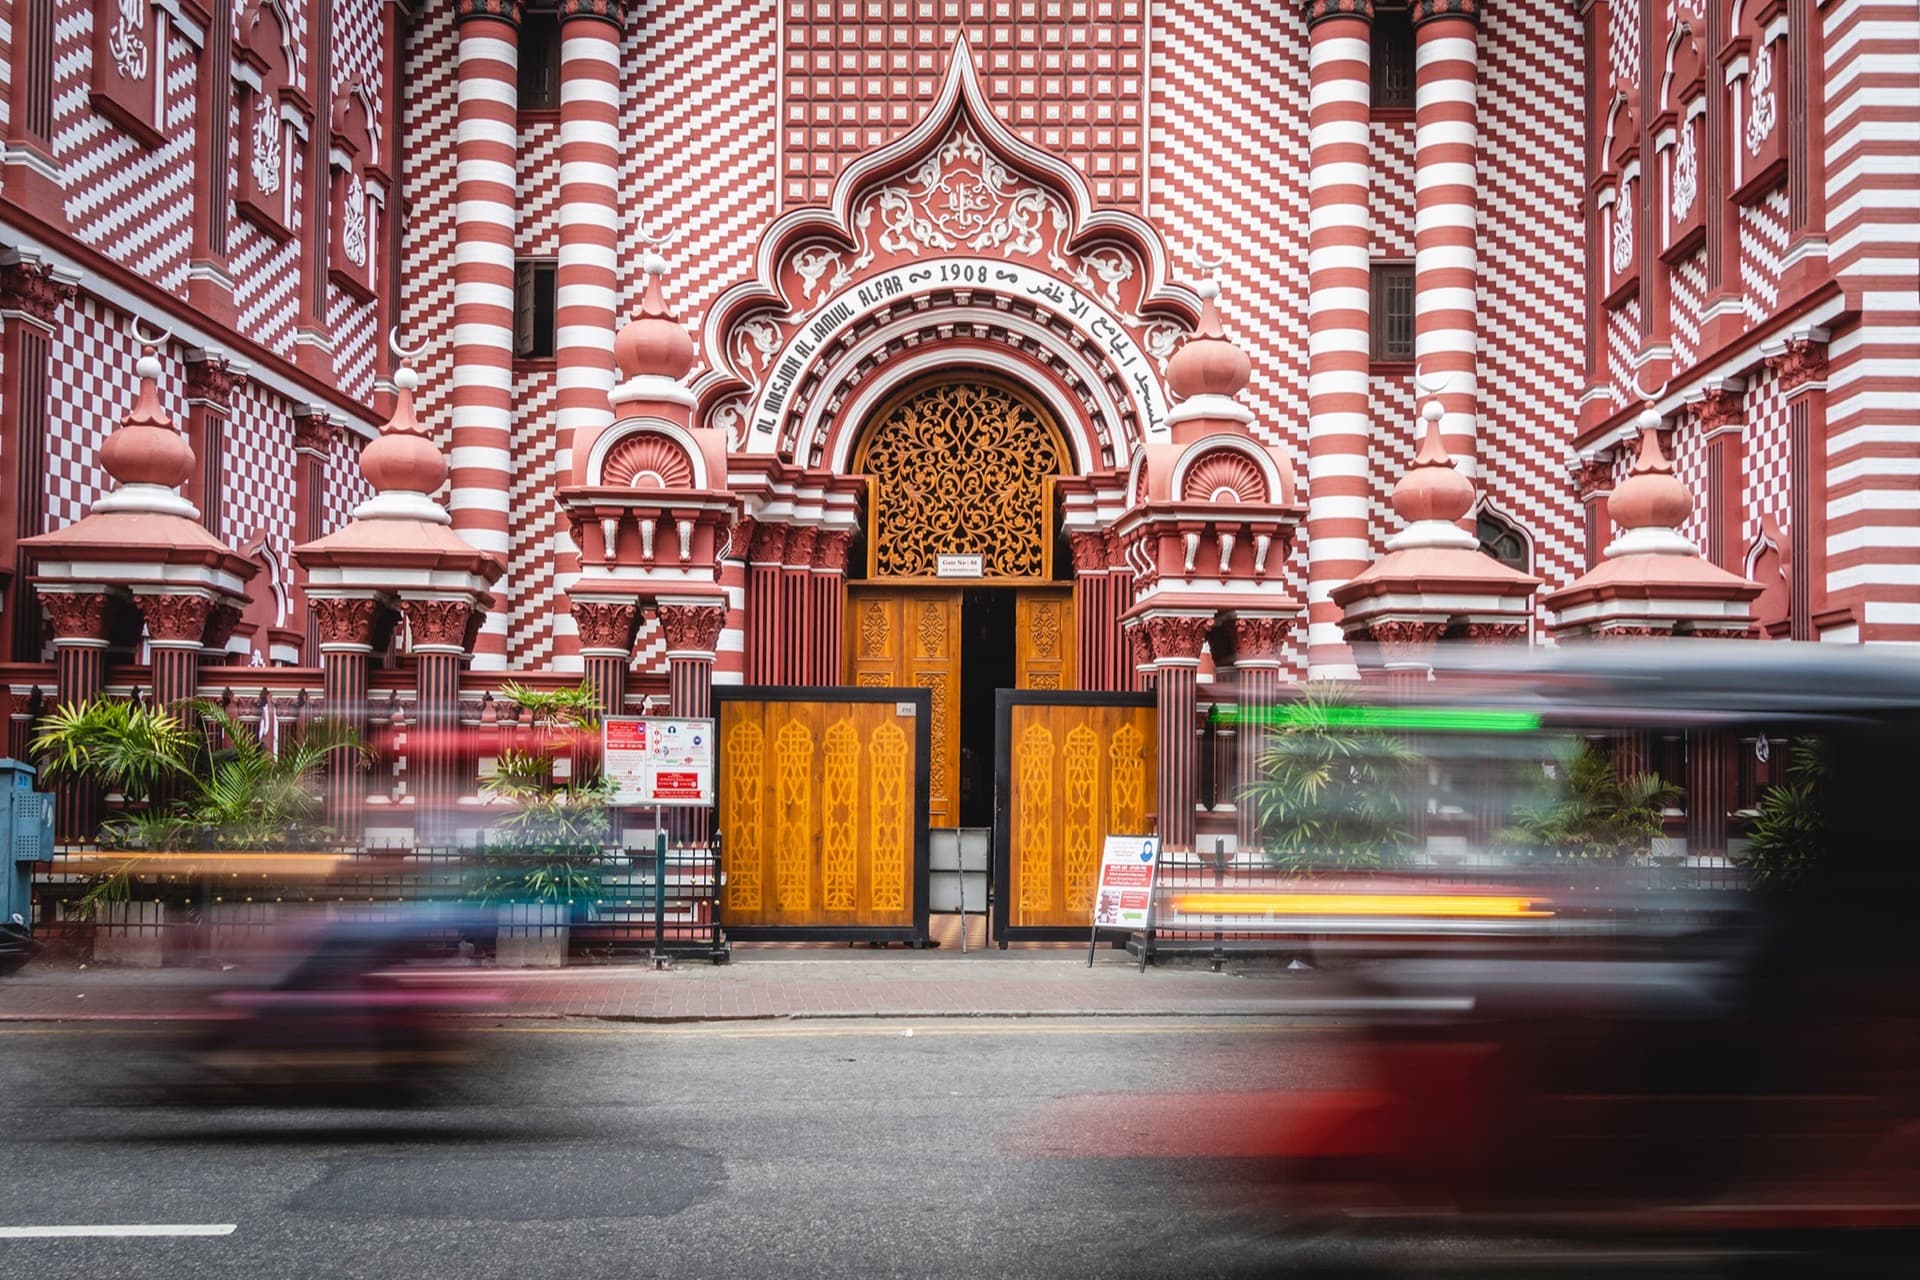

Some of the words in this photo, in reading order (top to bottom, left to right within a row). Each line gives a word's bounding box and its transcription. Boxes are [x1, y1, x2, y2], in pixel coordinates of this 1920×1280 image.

[940, 263, 987, 283] 1908
[857, 275, 903, 308] ALFAR
[809, 301, 855, 343] JAMIUL
[794, 340, 816, 359] AL
[763, 355, 803, 415] MASJIDH
[756, 418, 777, 435] AL
